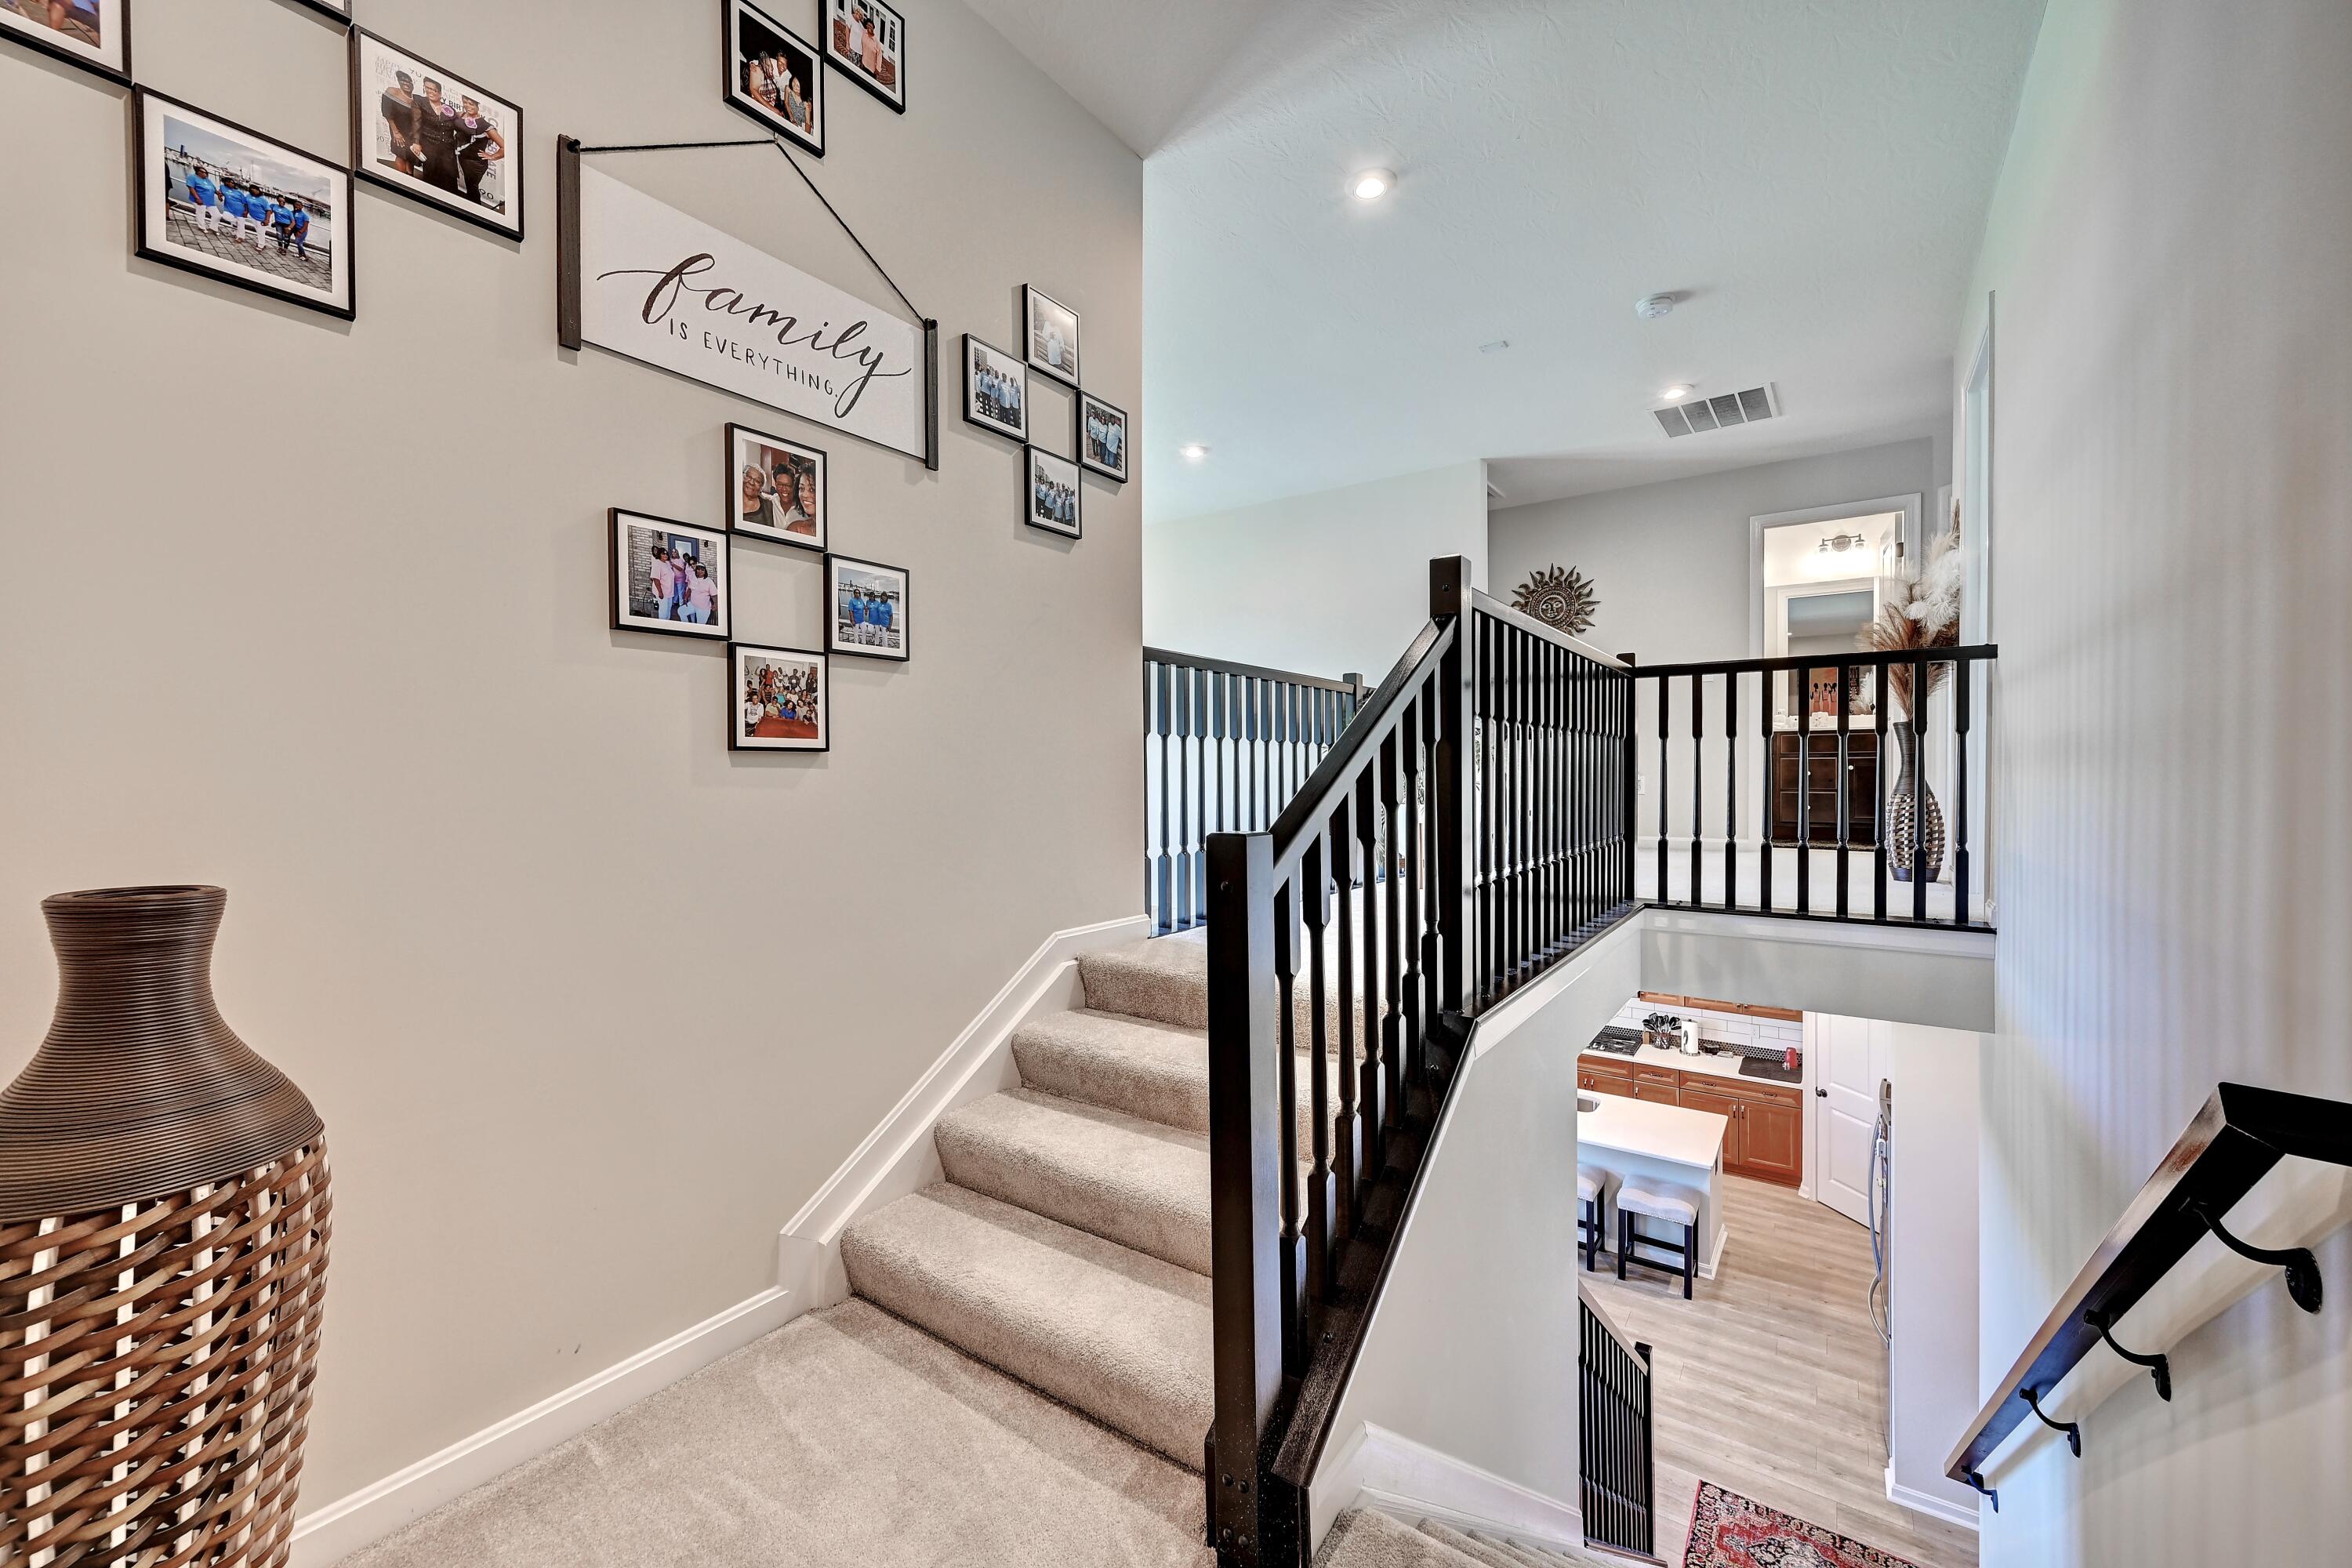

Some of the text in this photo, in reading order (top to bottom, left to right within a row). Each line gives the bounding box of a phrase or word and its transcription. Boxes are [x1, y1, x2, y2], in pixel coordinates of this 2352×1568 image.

[596, 252, 912, 419] family
[670, 317, 838, 398] IS EVERYTHING.
